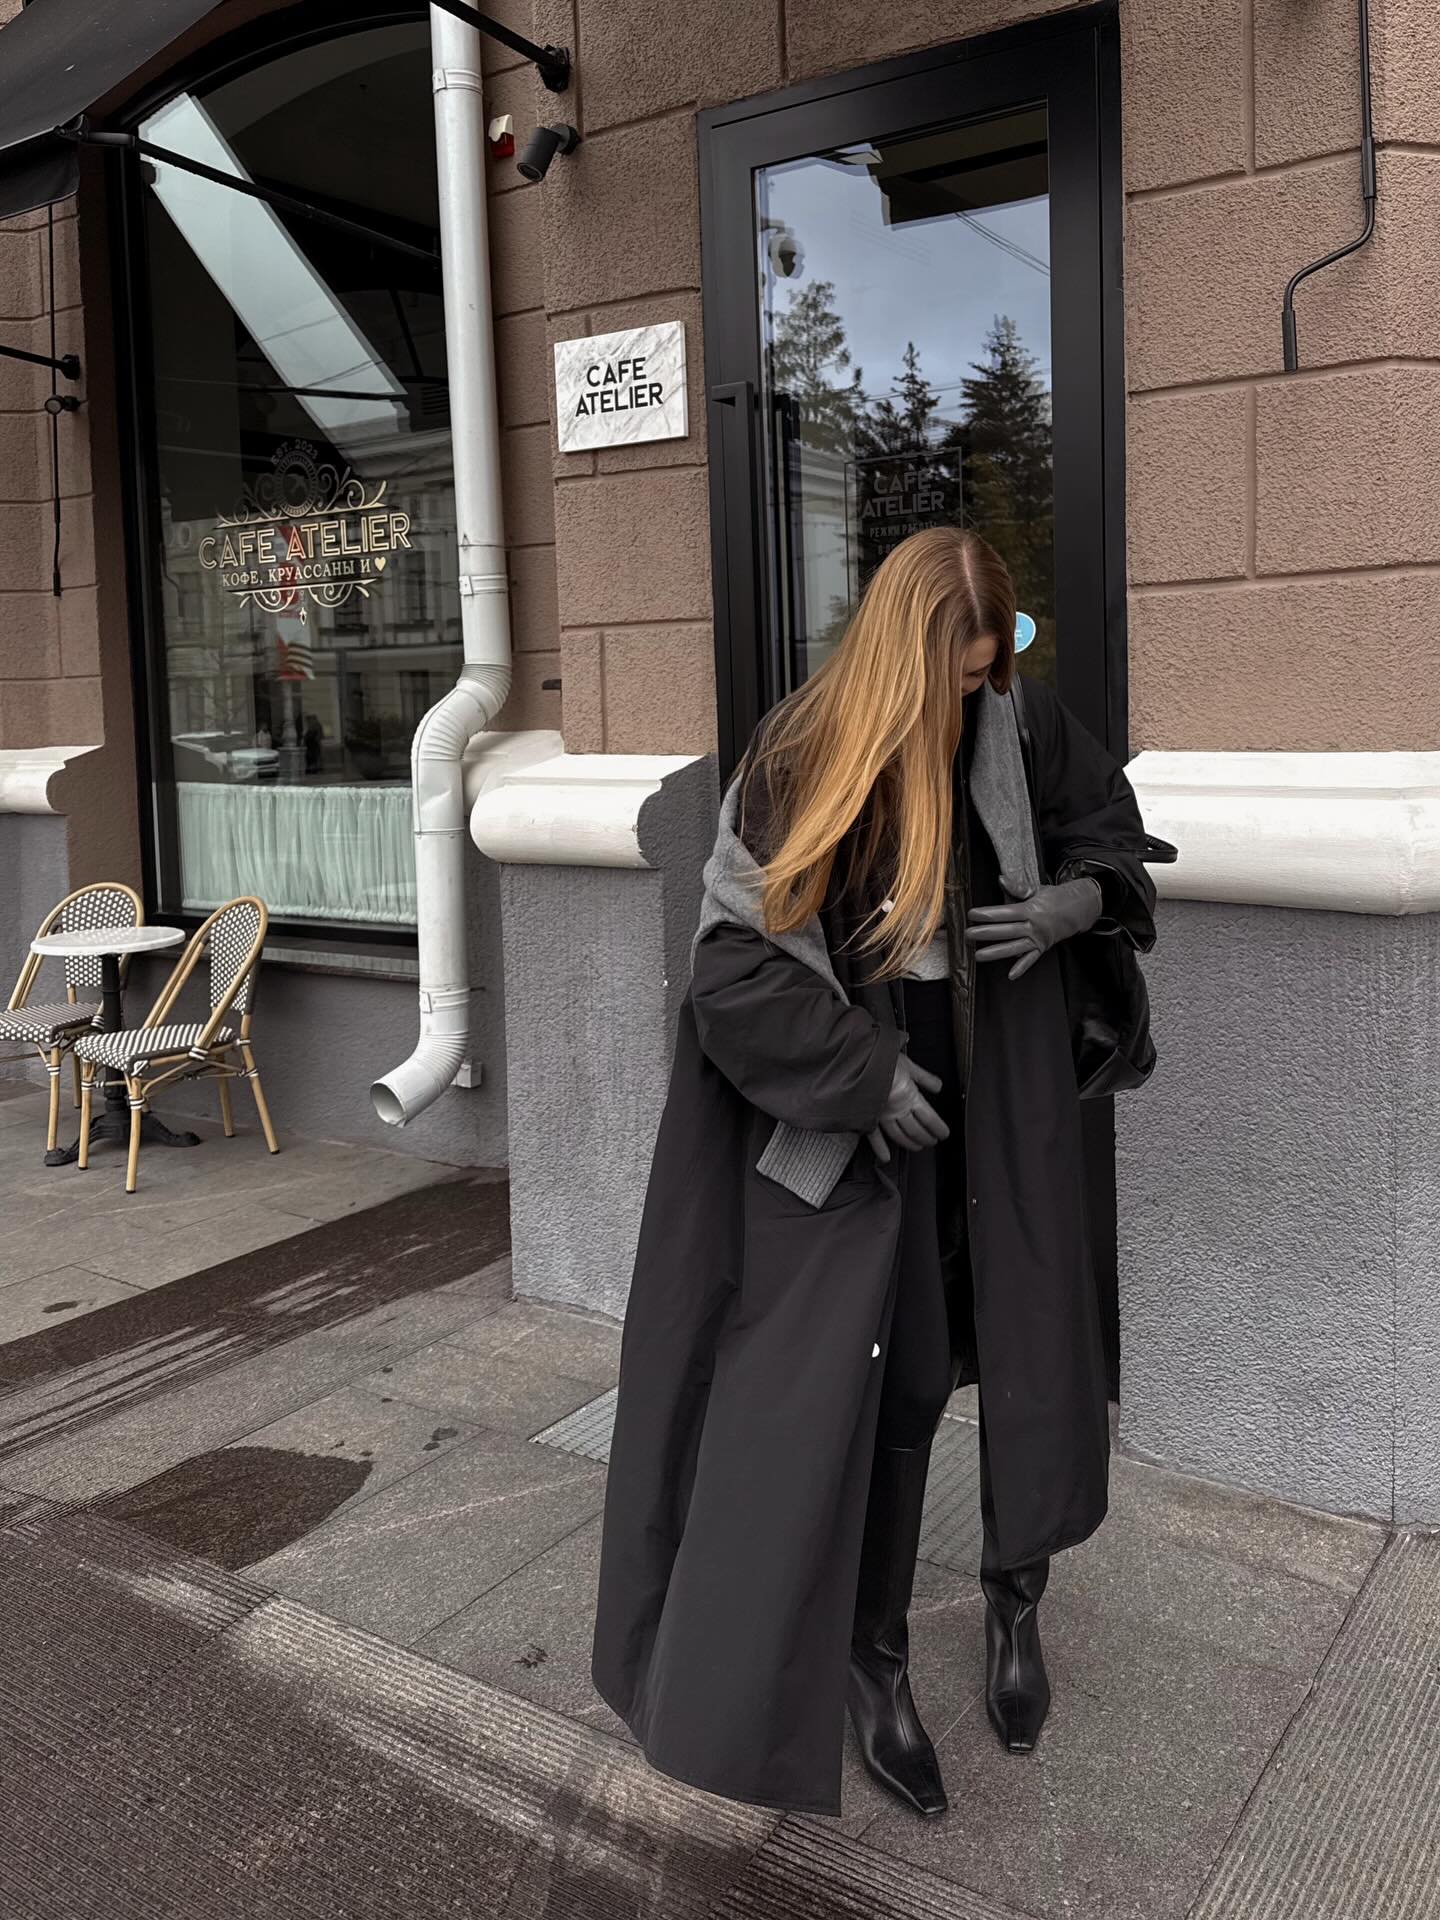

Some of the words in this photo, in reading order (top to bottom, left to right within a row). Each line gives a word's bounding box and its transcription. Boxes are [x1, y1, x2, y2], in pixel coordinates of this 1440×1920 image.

[587, 357, 647, 387] CAFE
[575, 382, 663, 417] ATELIER
[874, 470, 932, 494] CAFE
[861, 491, 945, 519] ATELIER
[198, 528, 276, 569] CAFE
[285, 512, 413, 561] ATELIER
[222, 571, 263, 587] КОФЕ,
[268, 561, 355, 583] КРУАССАНЫ
[360, 558, 371, 574] И
